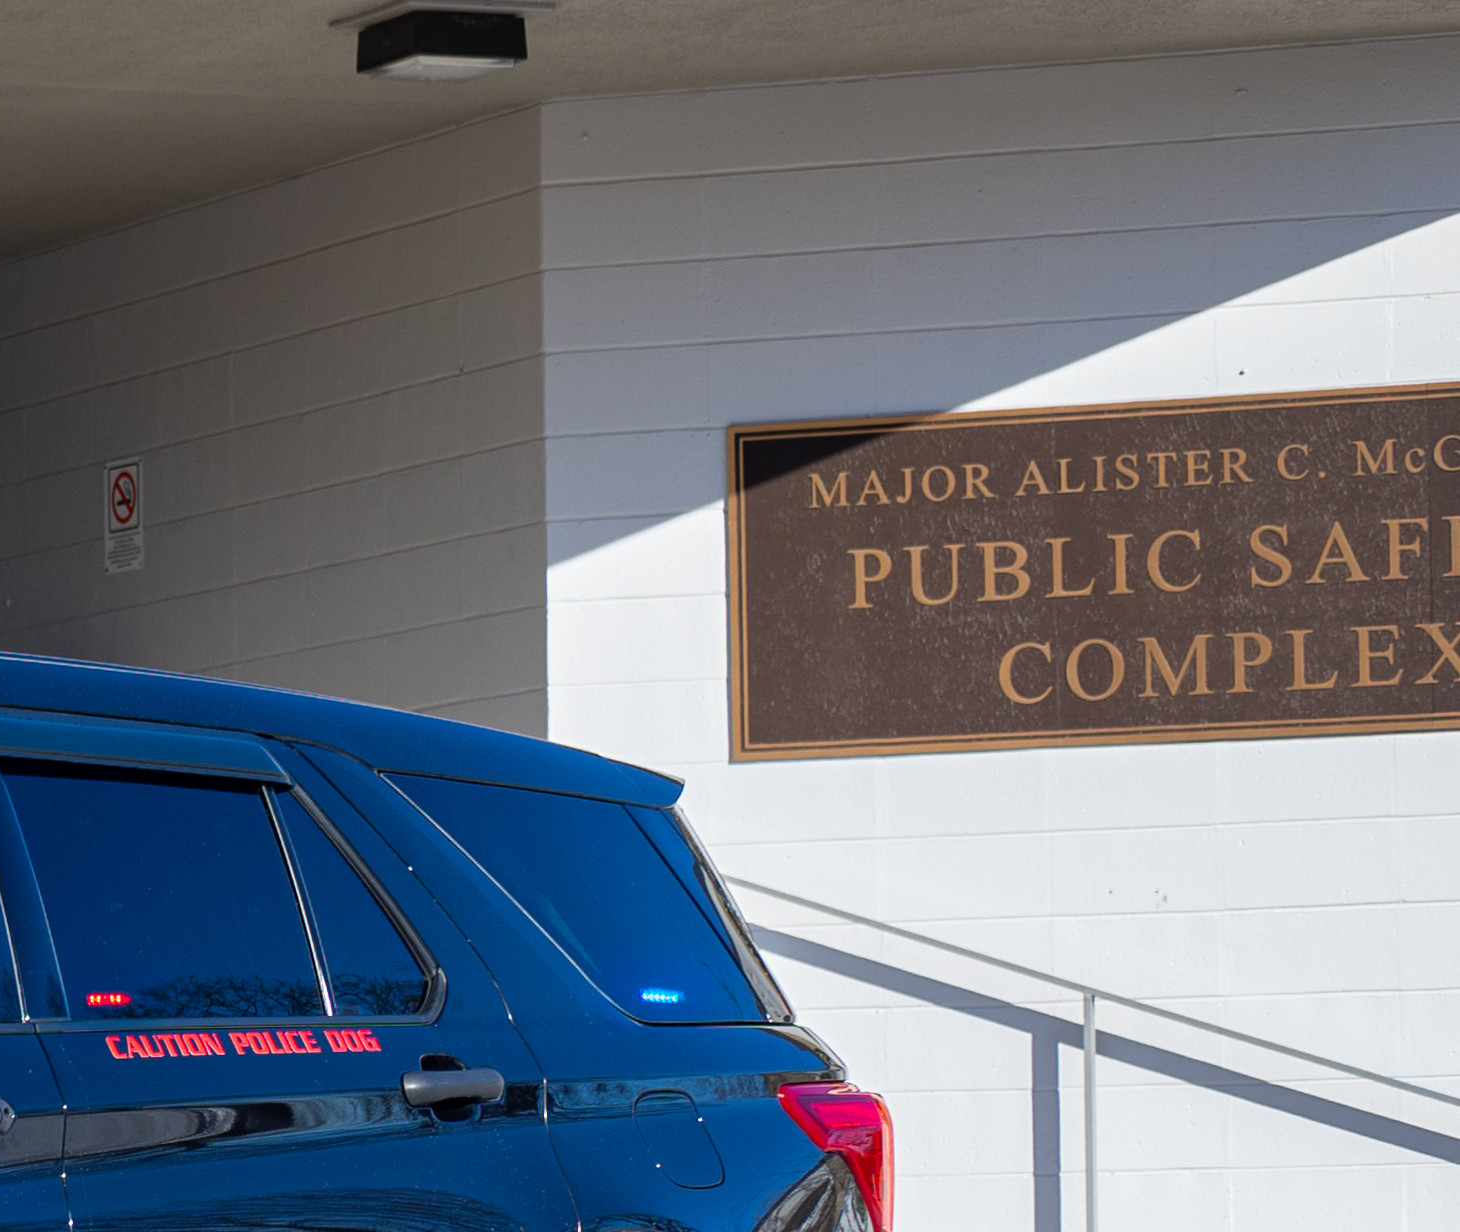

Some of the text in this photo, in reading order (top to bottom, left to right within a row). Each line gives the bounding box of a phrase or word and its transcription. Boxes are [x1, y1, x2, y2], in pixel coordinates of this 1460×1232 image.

[808, 463, 996, 509] MAJOR
[1014, 447, 1254, 496] ALISTER
[1276, 443, 1326, 481] C.
[846, 528, 1204, 609] PUBLIC
[998, 620, 1460, 706] COMPLEX
[105, 1028, 381, 1059] CAUTION POLICE DOG
